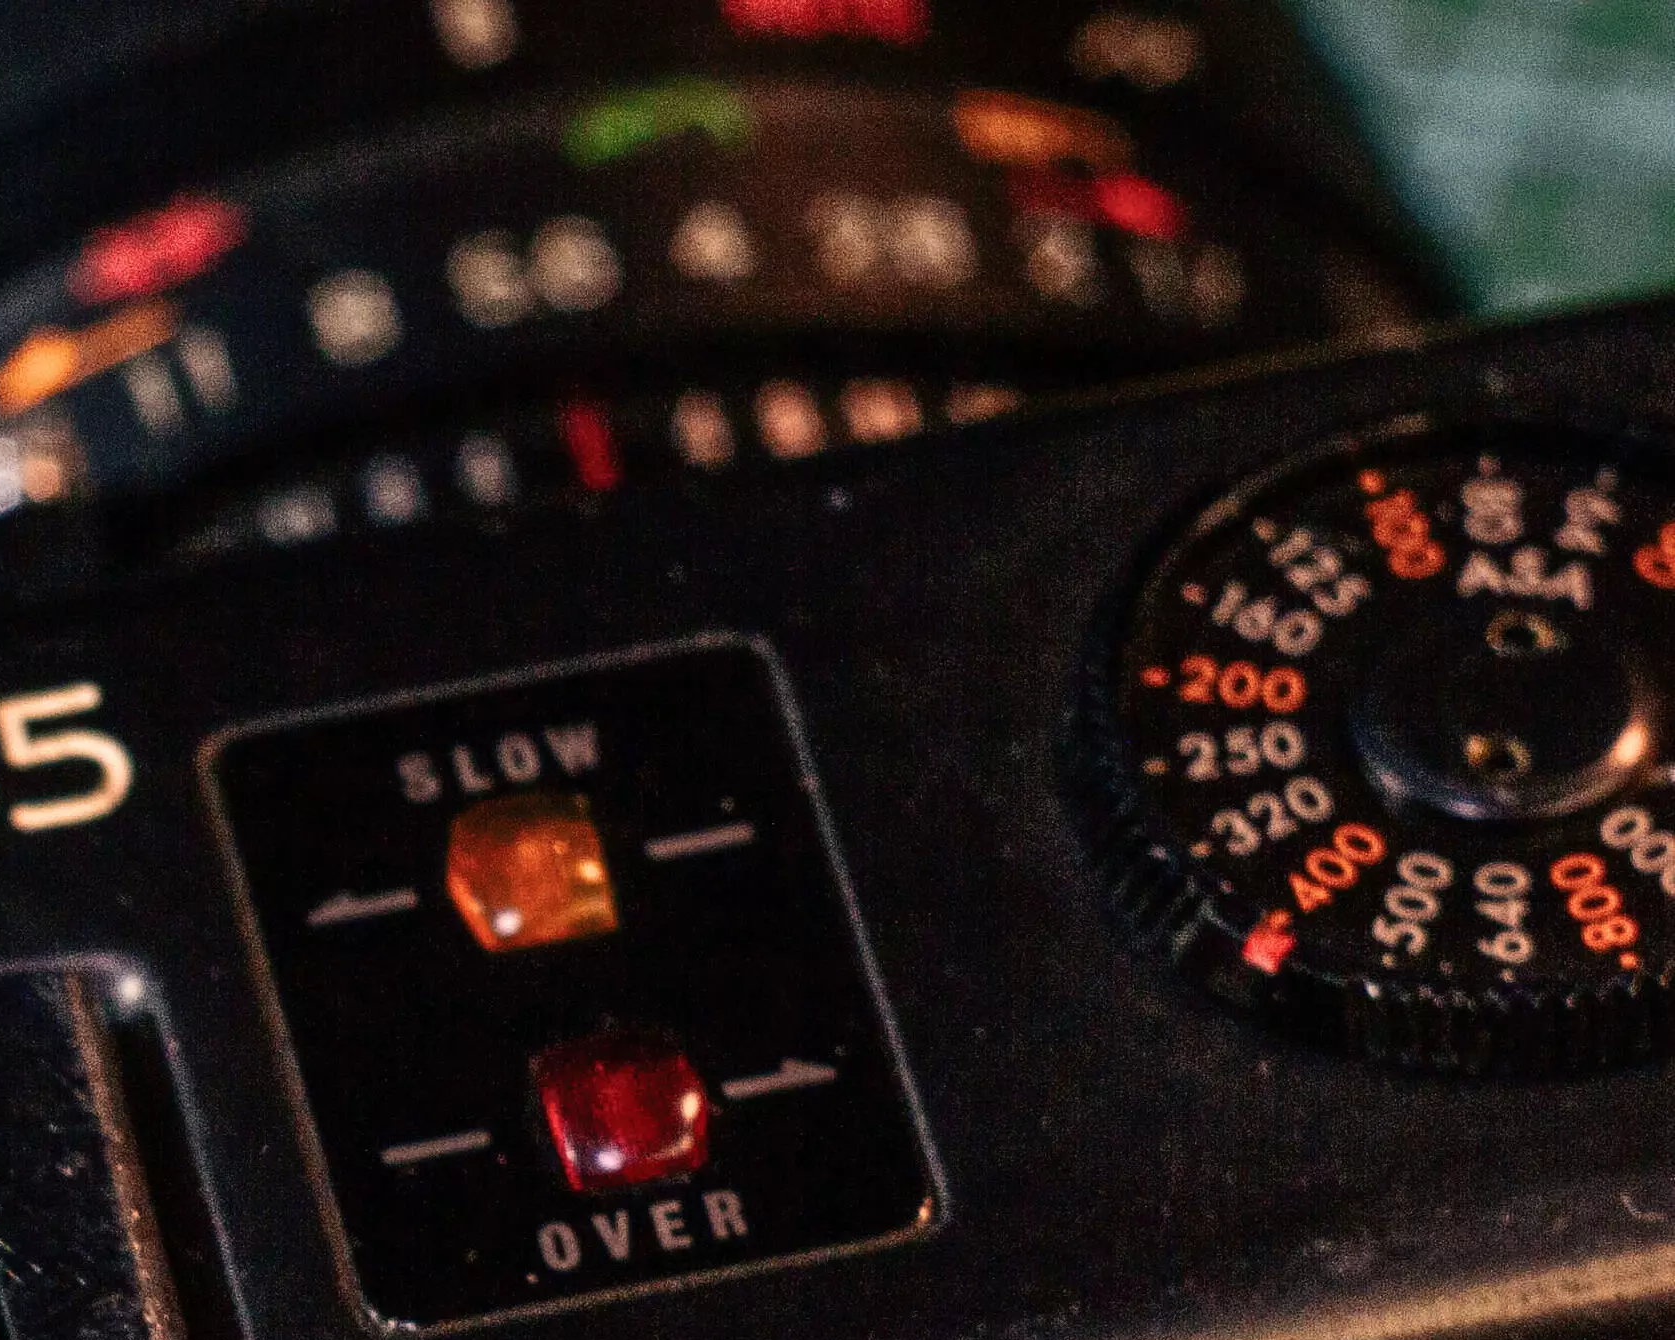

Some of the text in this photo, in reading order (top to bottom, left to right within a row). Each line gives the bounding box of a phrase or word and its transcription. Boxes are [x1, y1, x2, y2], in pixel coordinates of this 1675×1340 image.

[1212, 580, 1324, 656] 160
[1179, 653, 1307, 713] 200
[397, 722, 601, 802] SLOW
[1177, 719, 1307, 781] 250
[1212, 775, 1331, 856] 320
[1289, 822, 1387, 913] 400
[1372, 850, 1453, 955] 500
[1548, 851, 1640, 953] 800
[1473, 861, 1533, 963] 640
[537, 1189, 748, 1271] OVER
